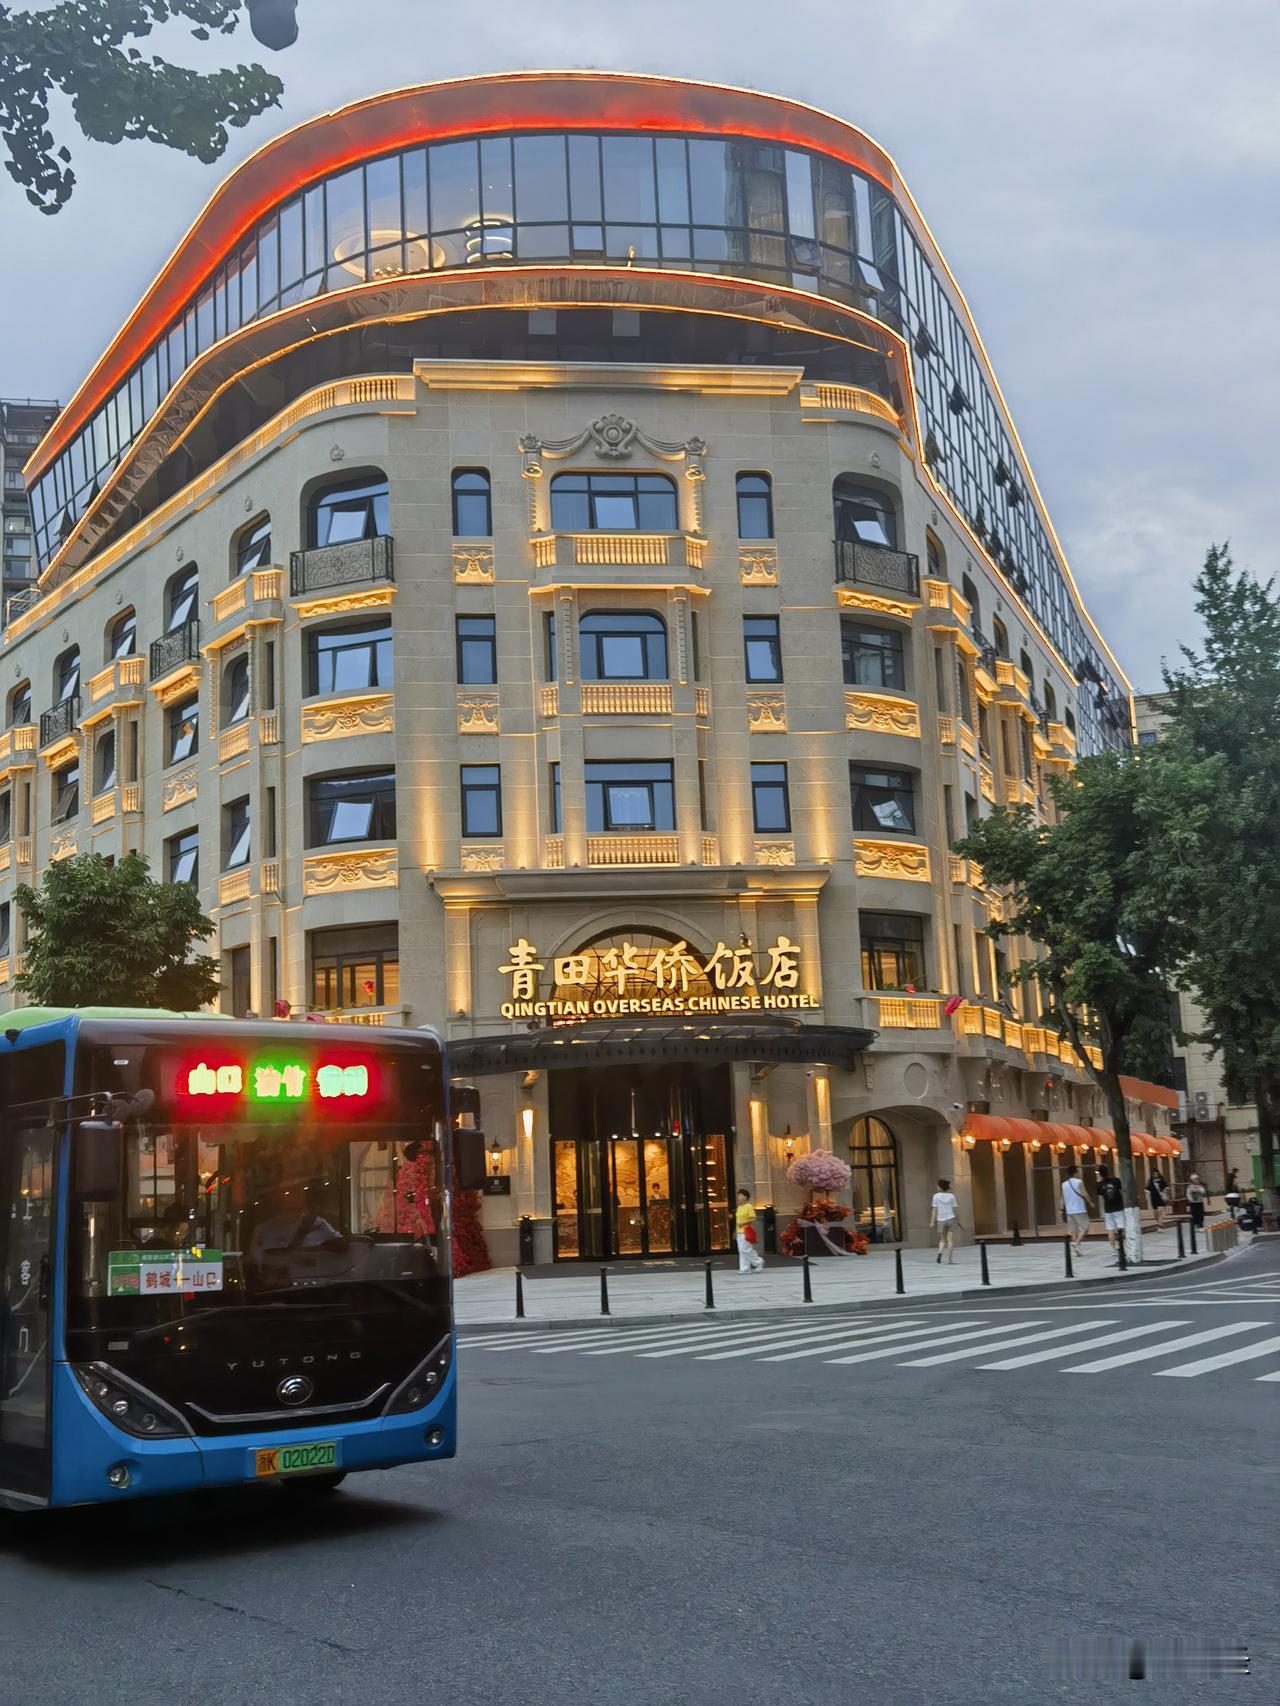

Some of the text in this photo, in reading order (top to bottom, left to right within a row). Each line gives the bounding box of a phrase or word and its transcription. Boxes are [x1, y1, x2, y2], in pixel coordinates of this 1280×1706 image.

[498, 936, 802, 1000] 青田华侨饭店
[501, 993, 819, 1019] QINGTIAN OVERSEAS CHINESE HOTEL
[226, 1352, 362, 1371] YUTONG
